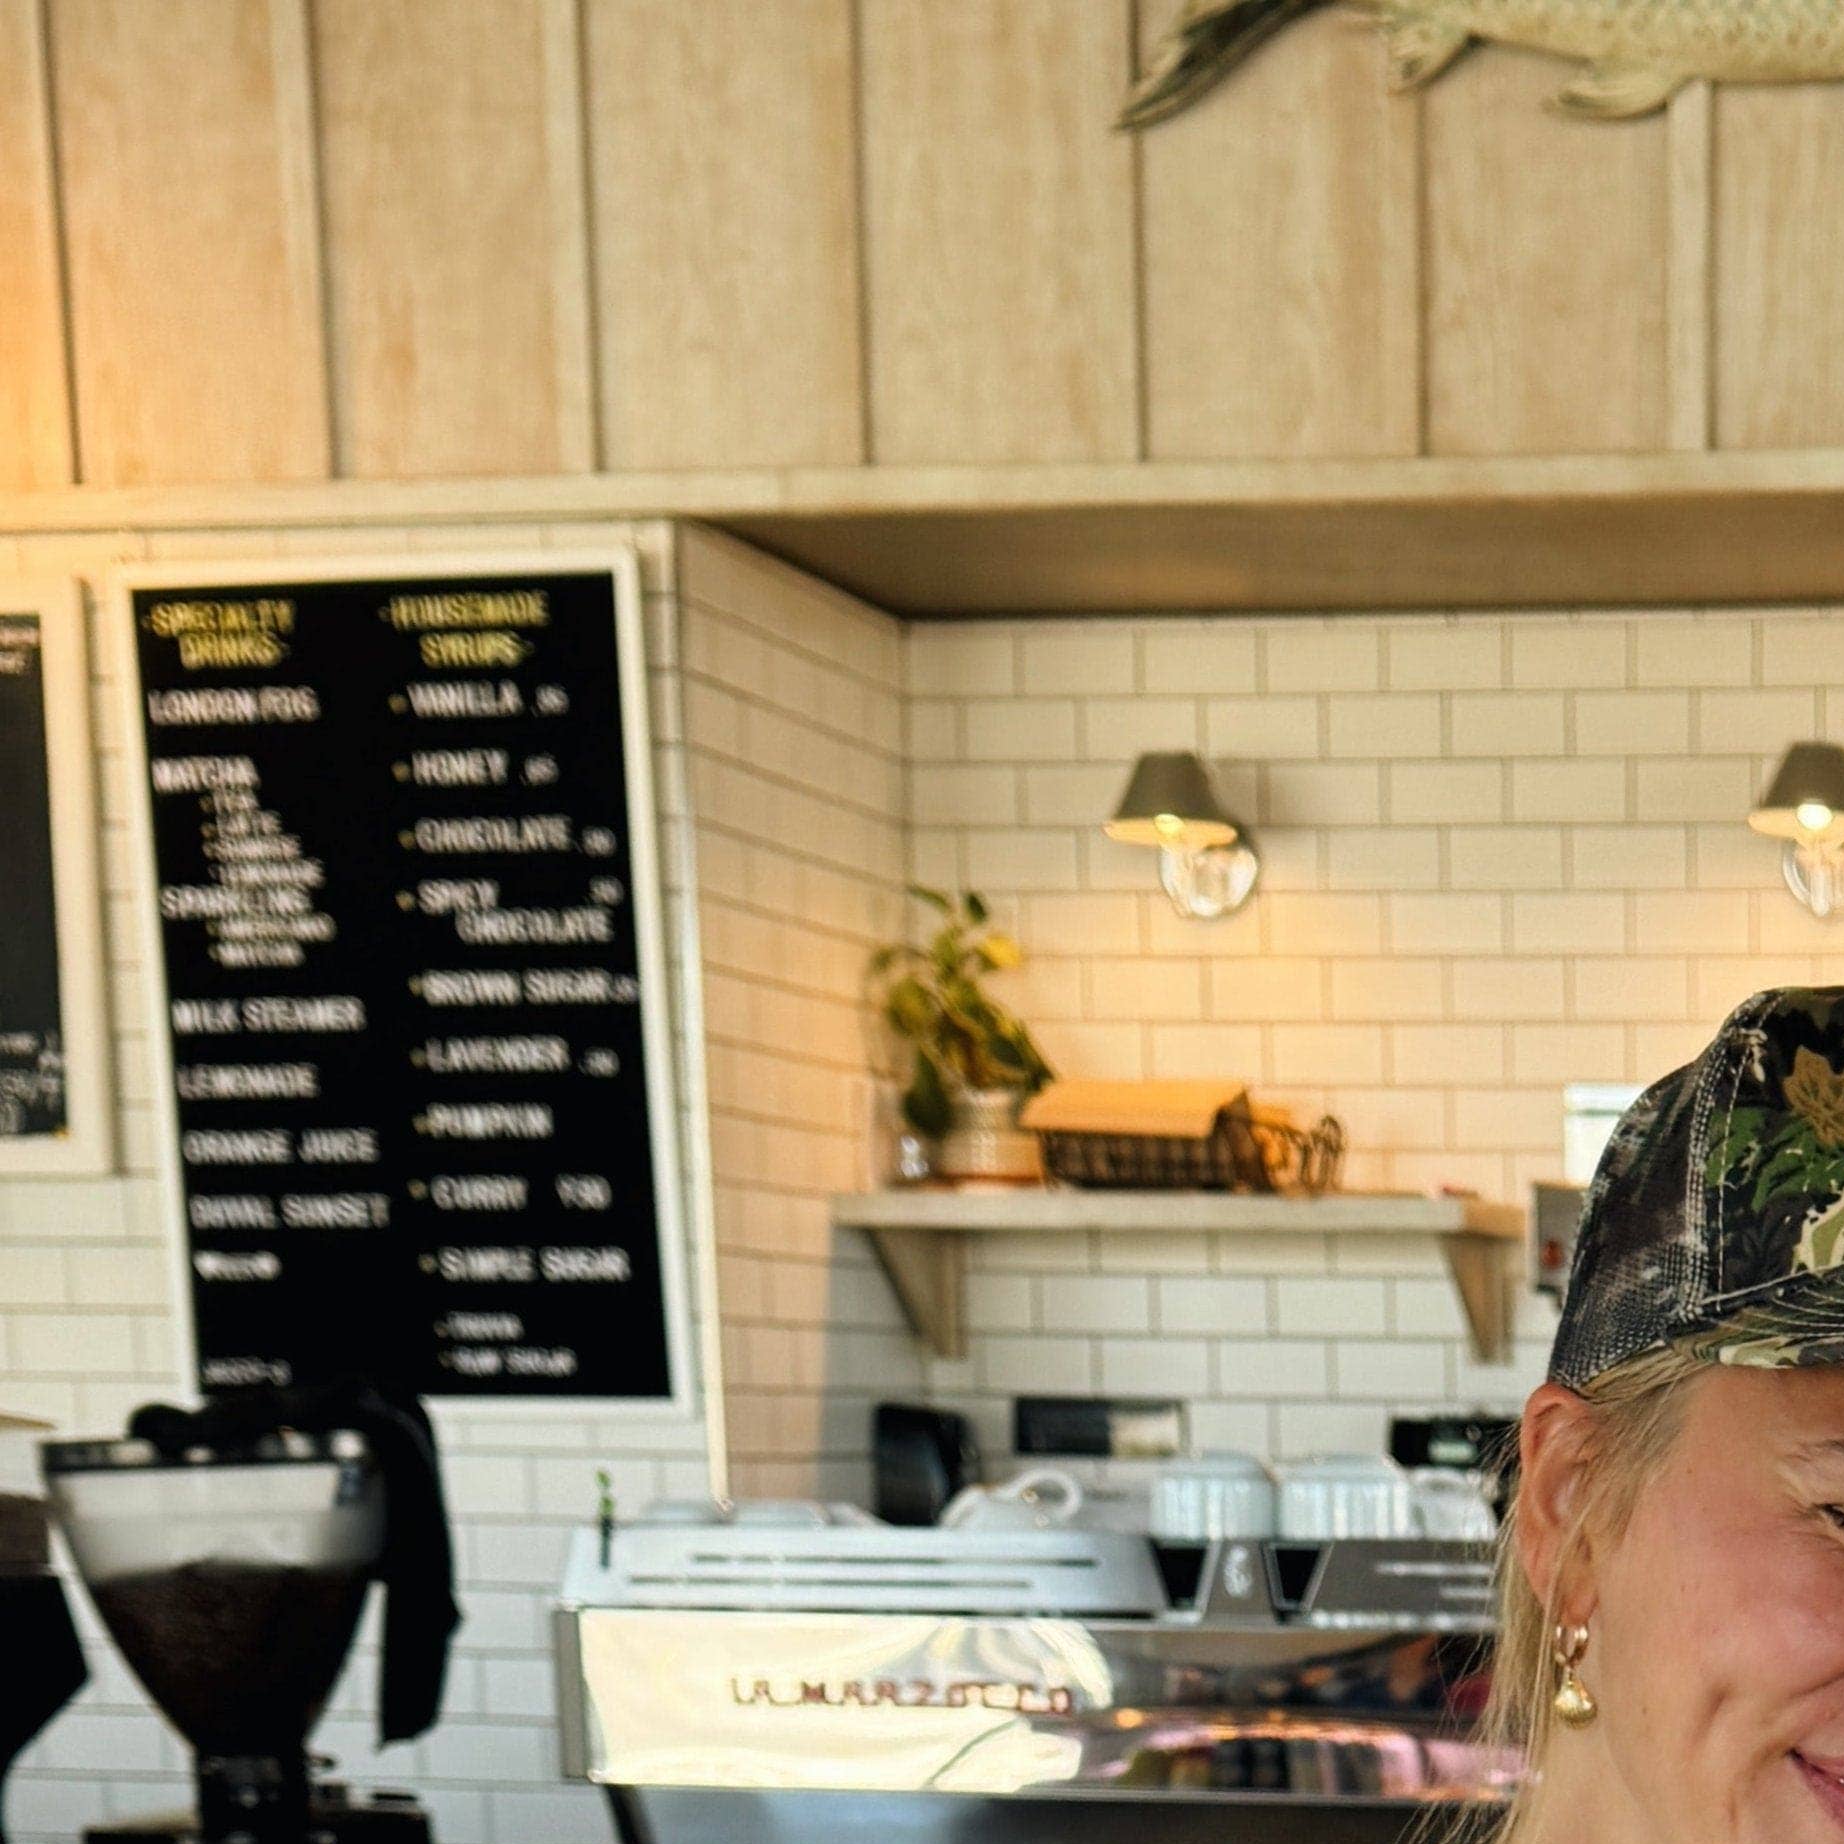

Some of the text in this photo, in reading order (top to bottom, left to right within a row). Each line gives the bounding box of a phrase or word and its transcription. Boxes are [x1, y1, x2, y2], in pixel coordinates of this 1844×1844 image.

[148, 685, 322, 726] LONDON FOG
[412, 748, 508, 785] HONEY
